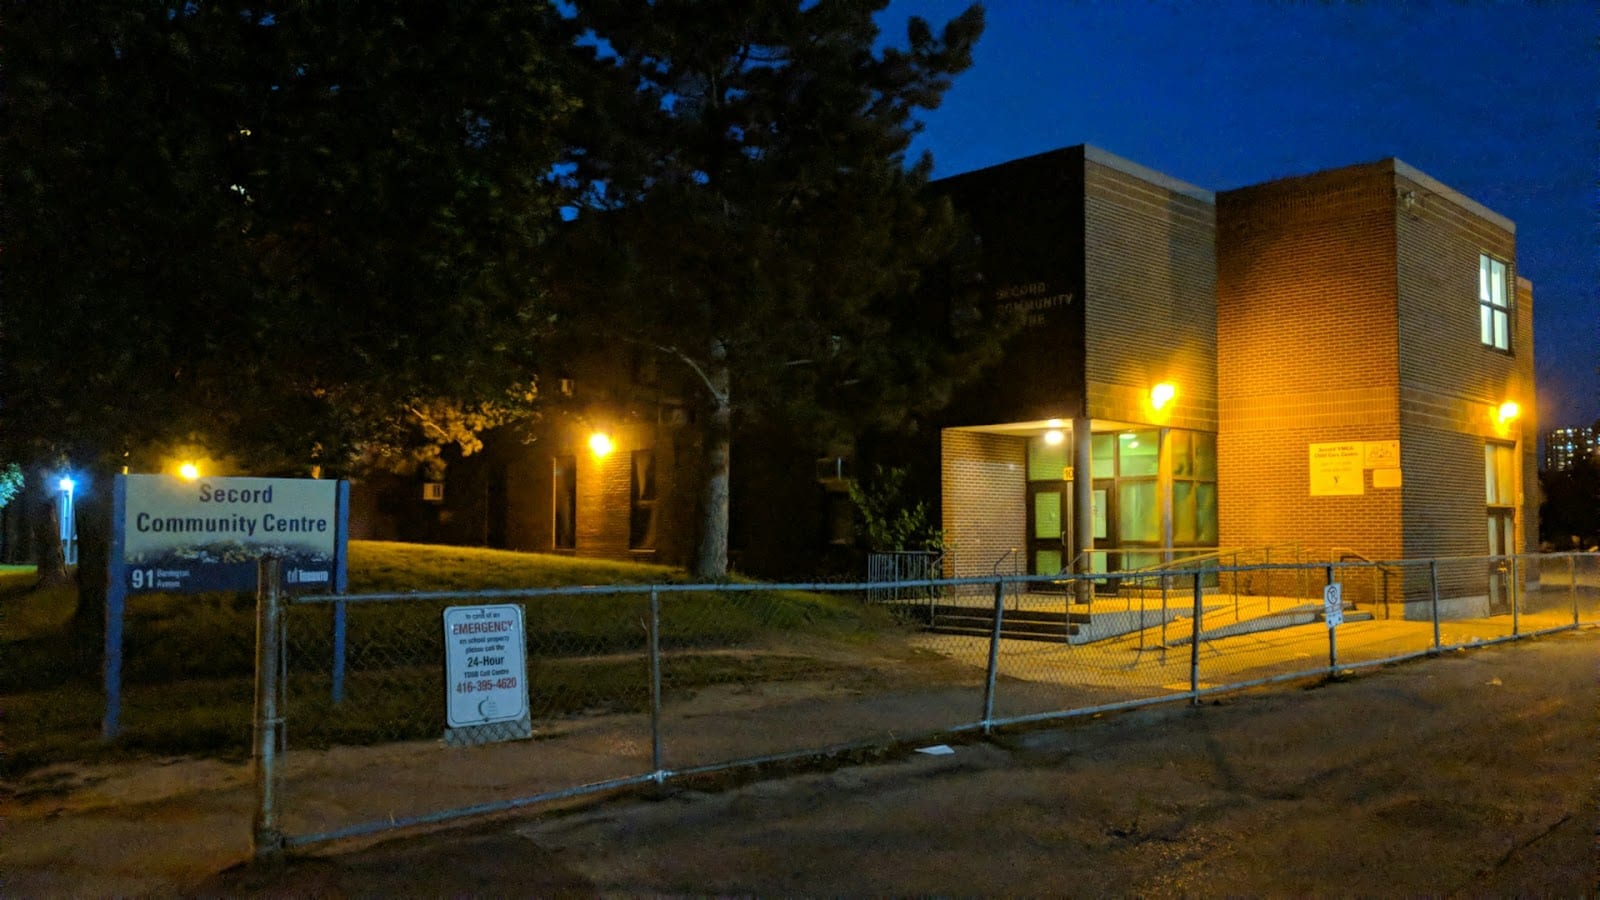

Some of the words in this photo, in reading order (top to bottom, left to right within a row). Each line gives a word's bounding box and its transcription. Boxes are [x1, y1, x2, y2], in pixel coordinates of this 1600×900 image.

[200, 484, 273, 503] Secord
[137, 512, 257, 536] Community
[263, 513, 327, 532] Centre
[131, 569, 153, 588] 91
[453, 620, 513, 635] EMERGENCY
[467, 656, 505, 668] 24-Hour
[456, 676, 517, 694] 416-395-4620
